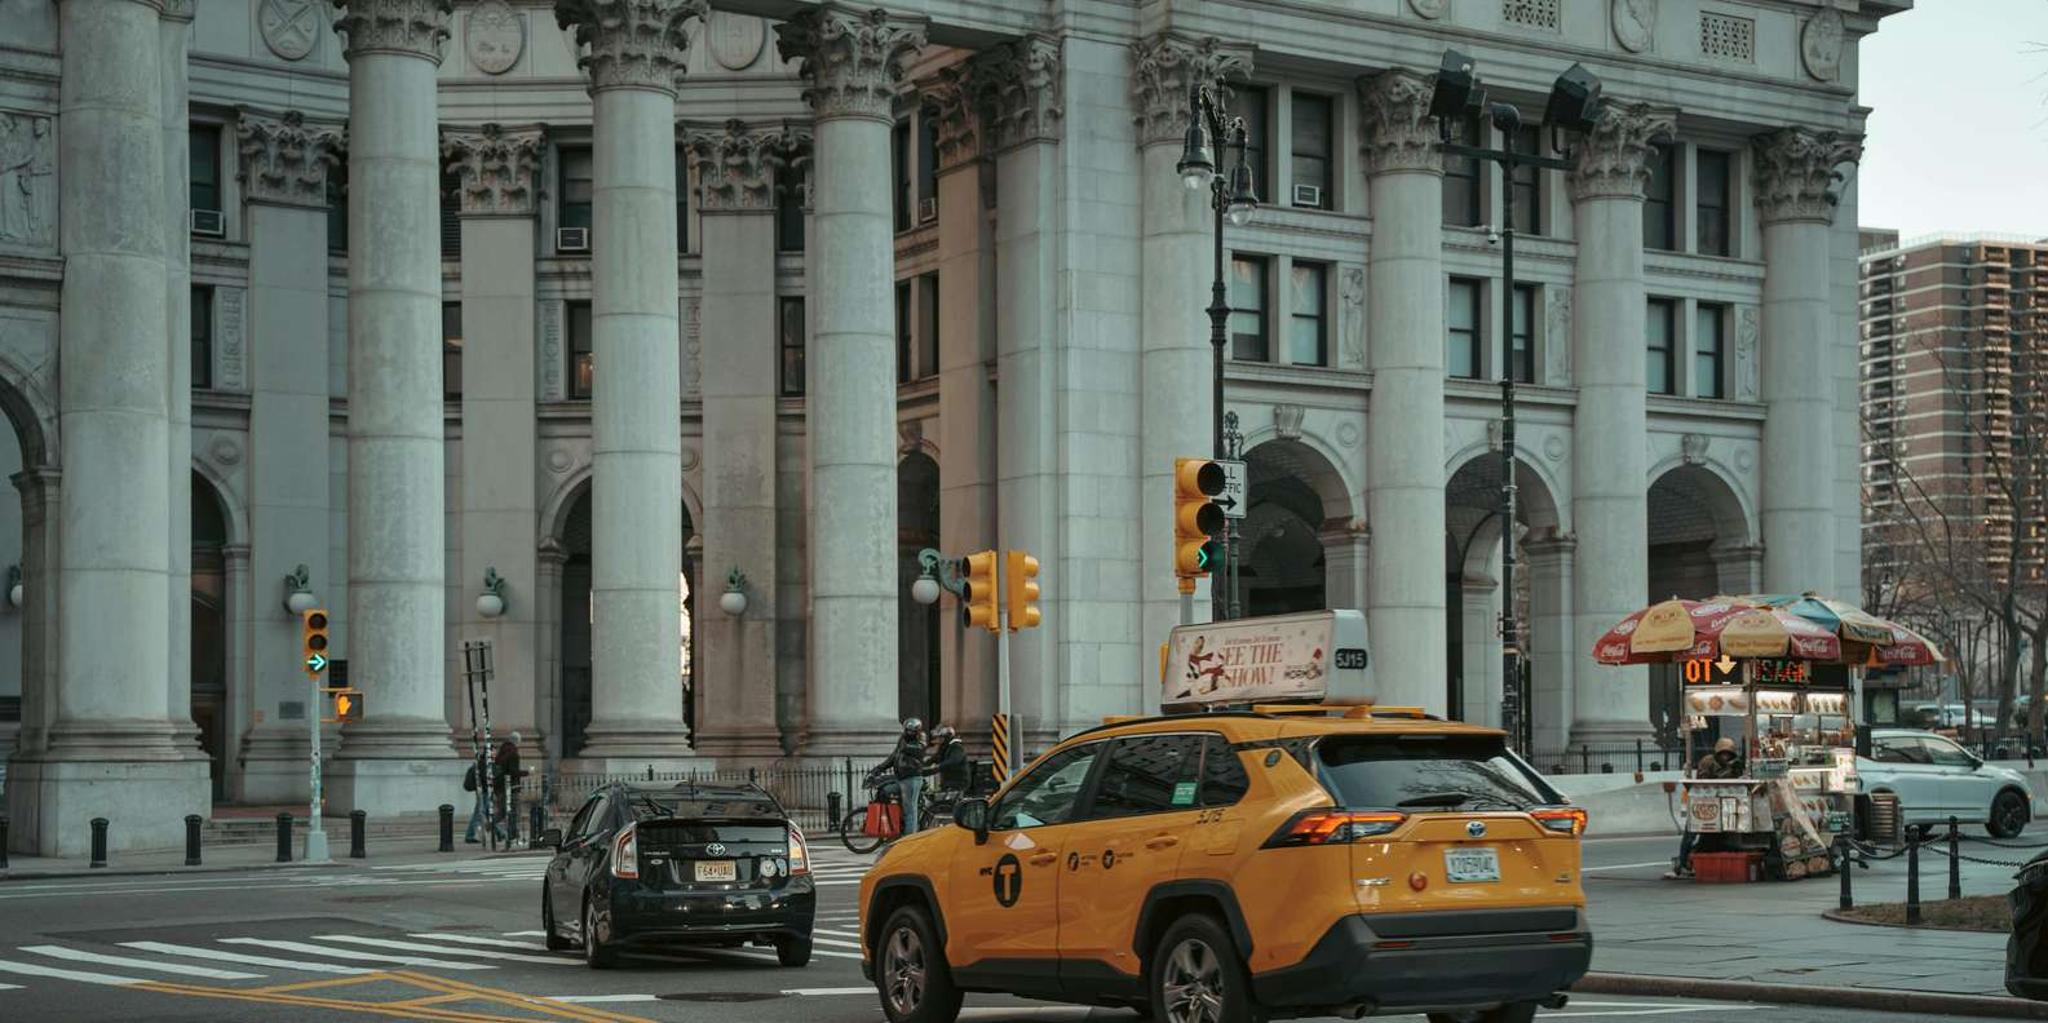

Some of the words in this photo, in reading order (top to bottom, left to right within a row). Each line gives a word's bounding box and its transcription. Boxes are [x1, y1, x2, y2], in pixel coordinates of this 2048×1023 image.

[1250, 642, 1284, 664] THE
[1336, 652, 1365, 668] 5J15
[1223, 665, 1275, 689] SHOW!
[1000, 863, 1017, 901] T
